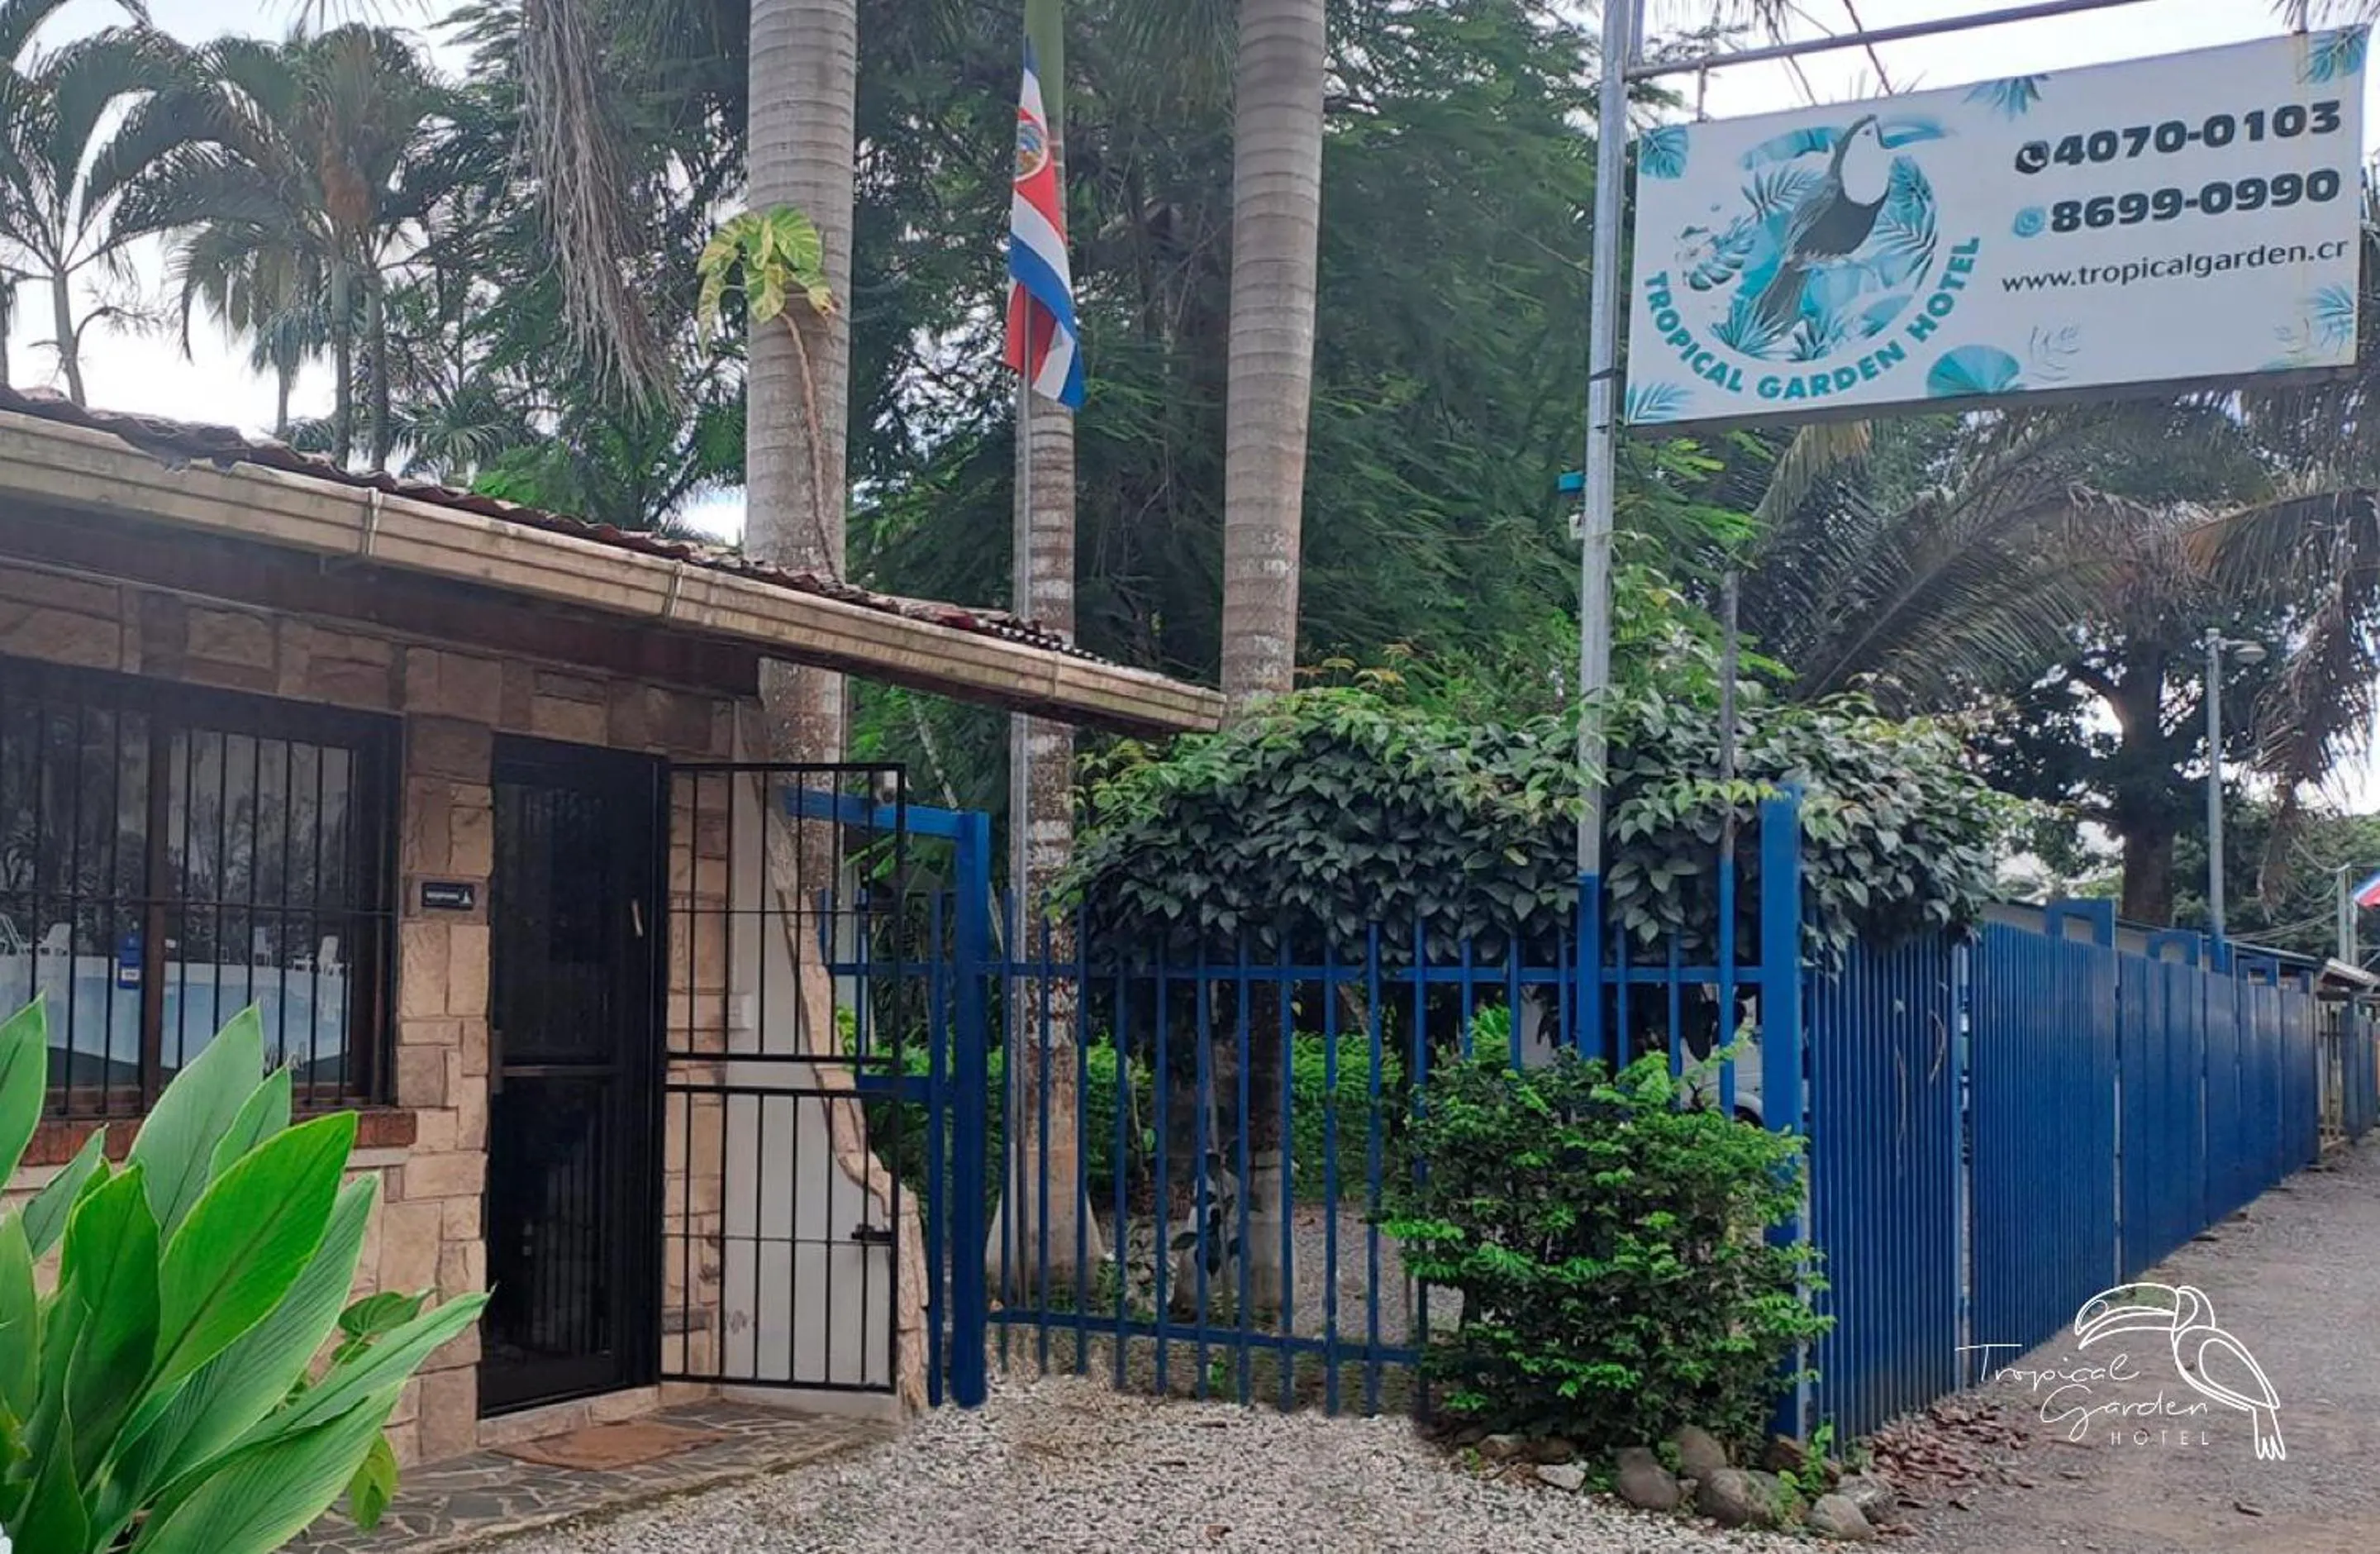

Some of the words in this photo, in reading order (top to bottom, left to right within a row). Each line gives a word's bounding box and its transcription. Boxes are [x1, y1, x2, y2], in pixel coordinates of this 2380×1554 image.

[2054, 100, 2340, 166] 4070-0103
[2051, 169, 2340, 232] 8699-0990
[2002, 239, 2349, 293] www.tropicalgarden.cr
[1645, 270, 1743, 393] TROPICAL
[1756, 339, 1908, 401] GARDEN
[1905, 236, 1980, 343] HOTEL
